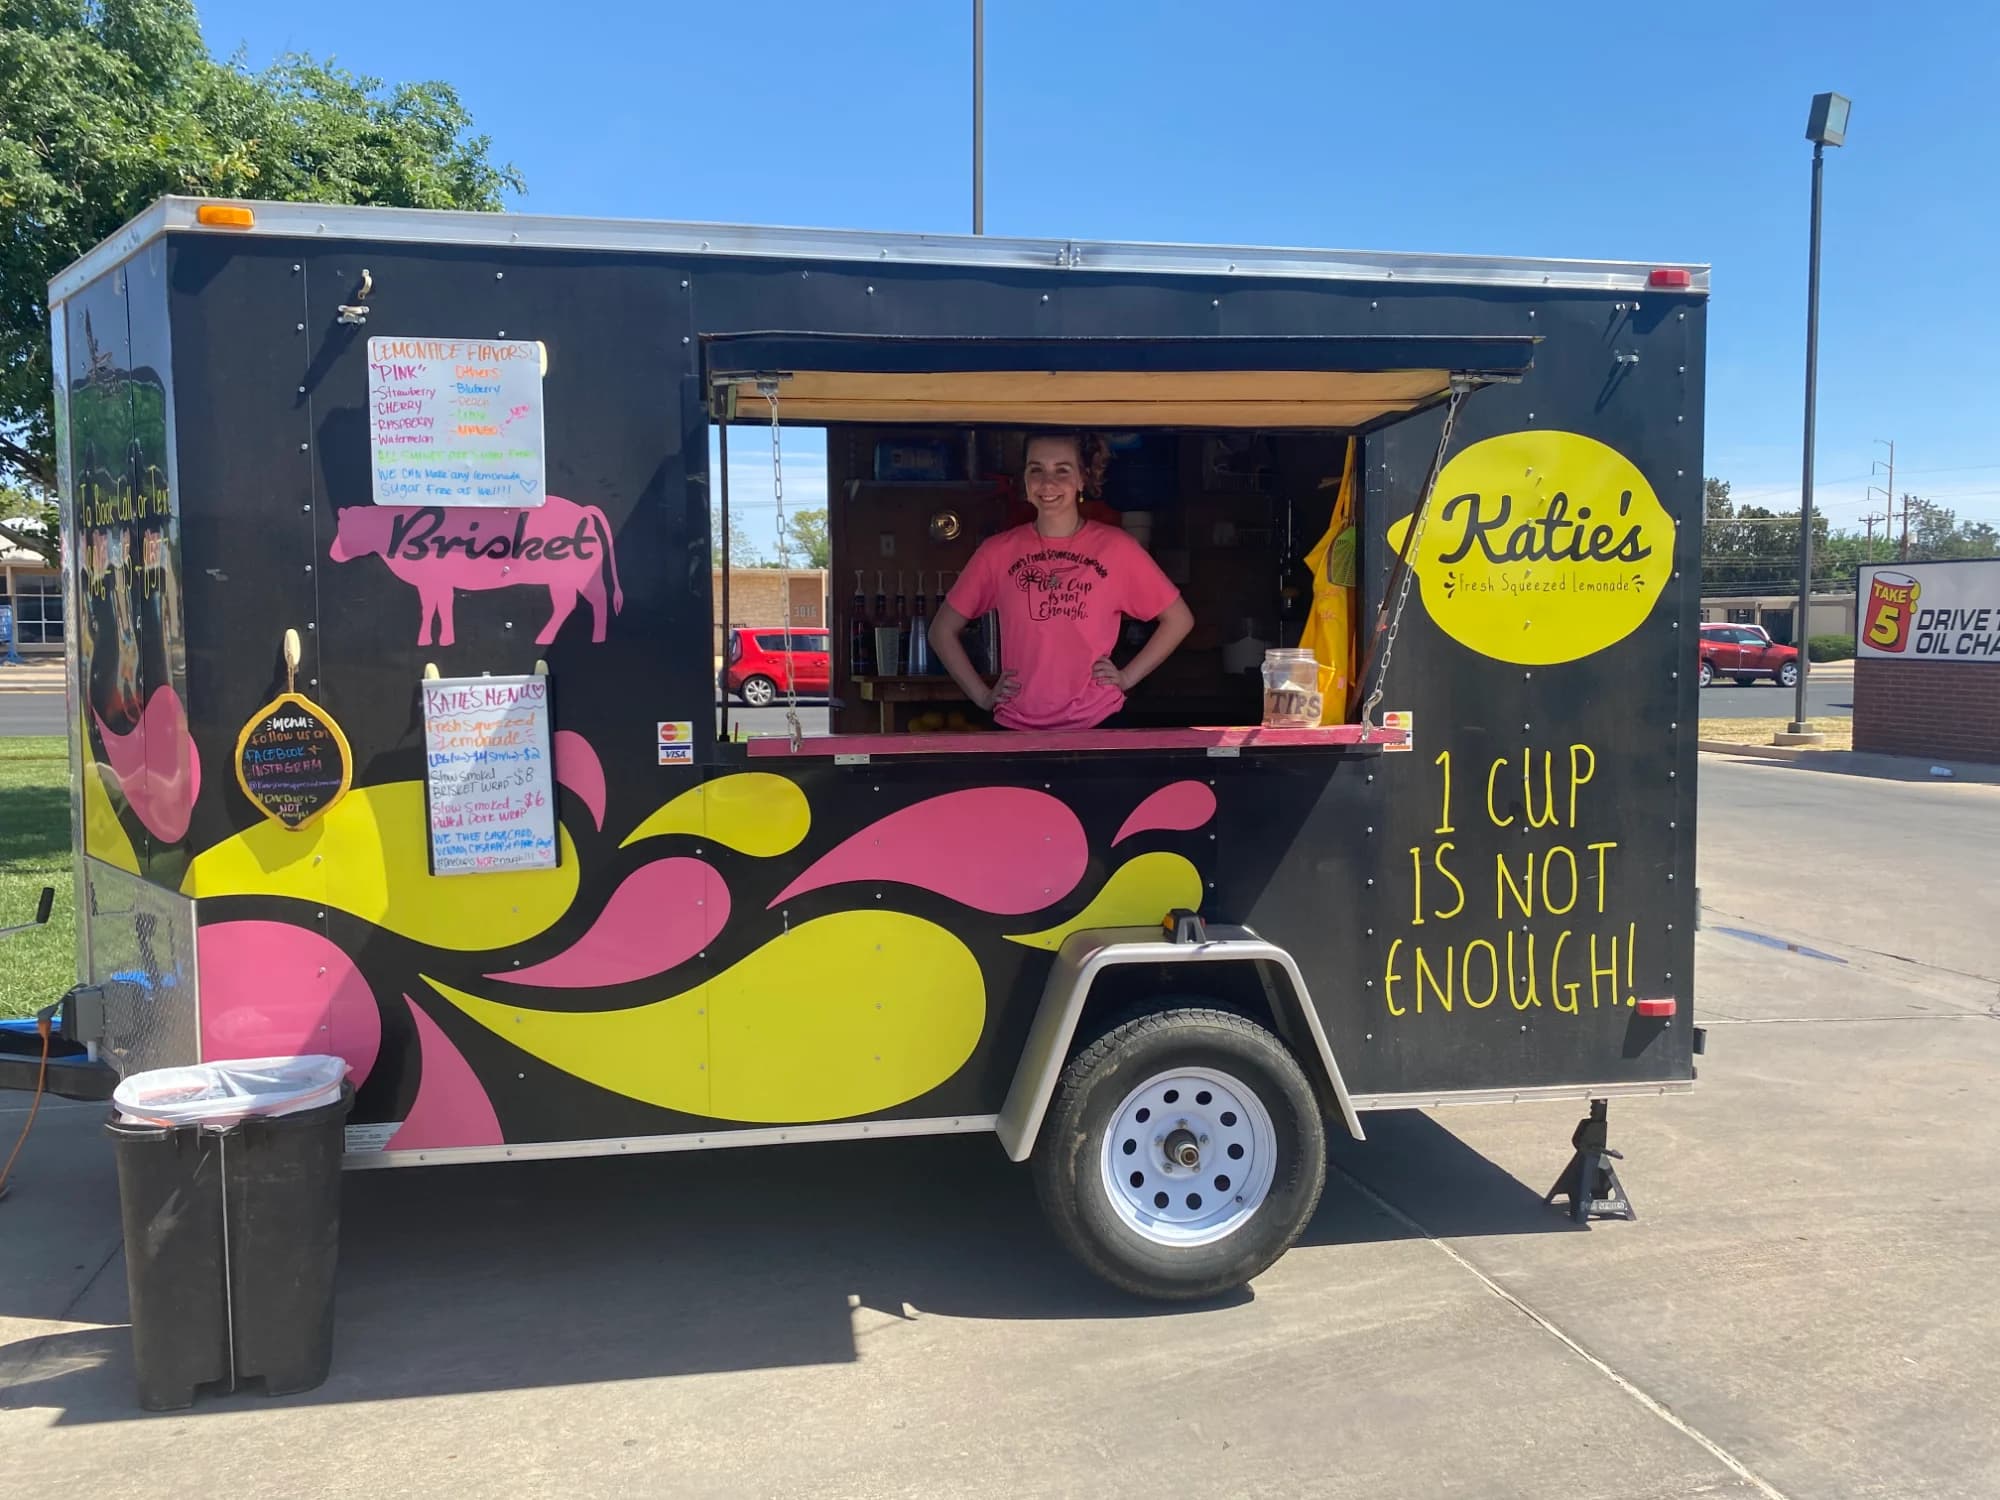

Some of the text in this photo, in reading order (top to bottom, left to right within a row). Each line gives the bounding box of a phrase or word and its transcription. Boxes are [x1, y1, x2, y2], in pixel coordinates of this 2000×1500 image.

[137, 494, 148, 519] or
[387, 506, 598, 561] Brisket
[1437, 489, 1652, 564] Katie's
[1066, 577, 1093, 596] Cup
[1459, 572, 1630, 597] Fresh Squeezed Lemonade
[1873, 583, 1908, 603] TAKE
[1869, 604, 1900, 647] 5
[1916, 608, 1992, 631] DRIVE
[1916, 632, 1951, 655] OIL
[1269, 691, 1322, 719] TIPS
[665, 750, 687, 759] VISA
[1434, 743, 1596, 834] 1 CUP
[1408, 841, 1618, 925] IS NOT
[1384, 922, 1637, 1017] ENOUGH!
